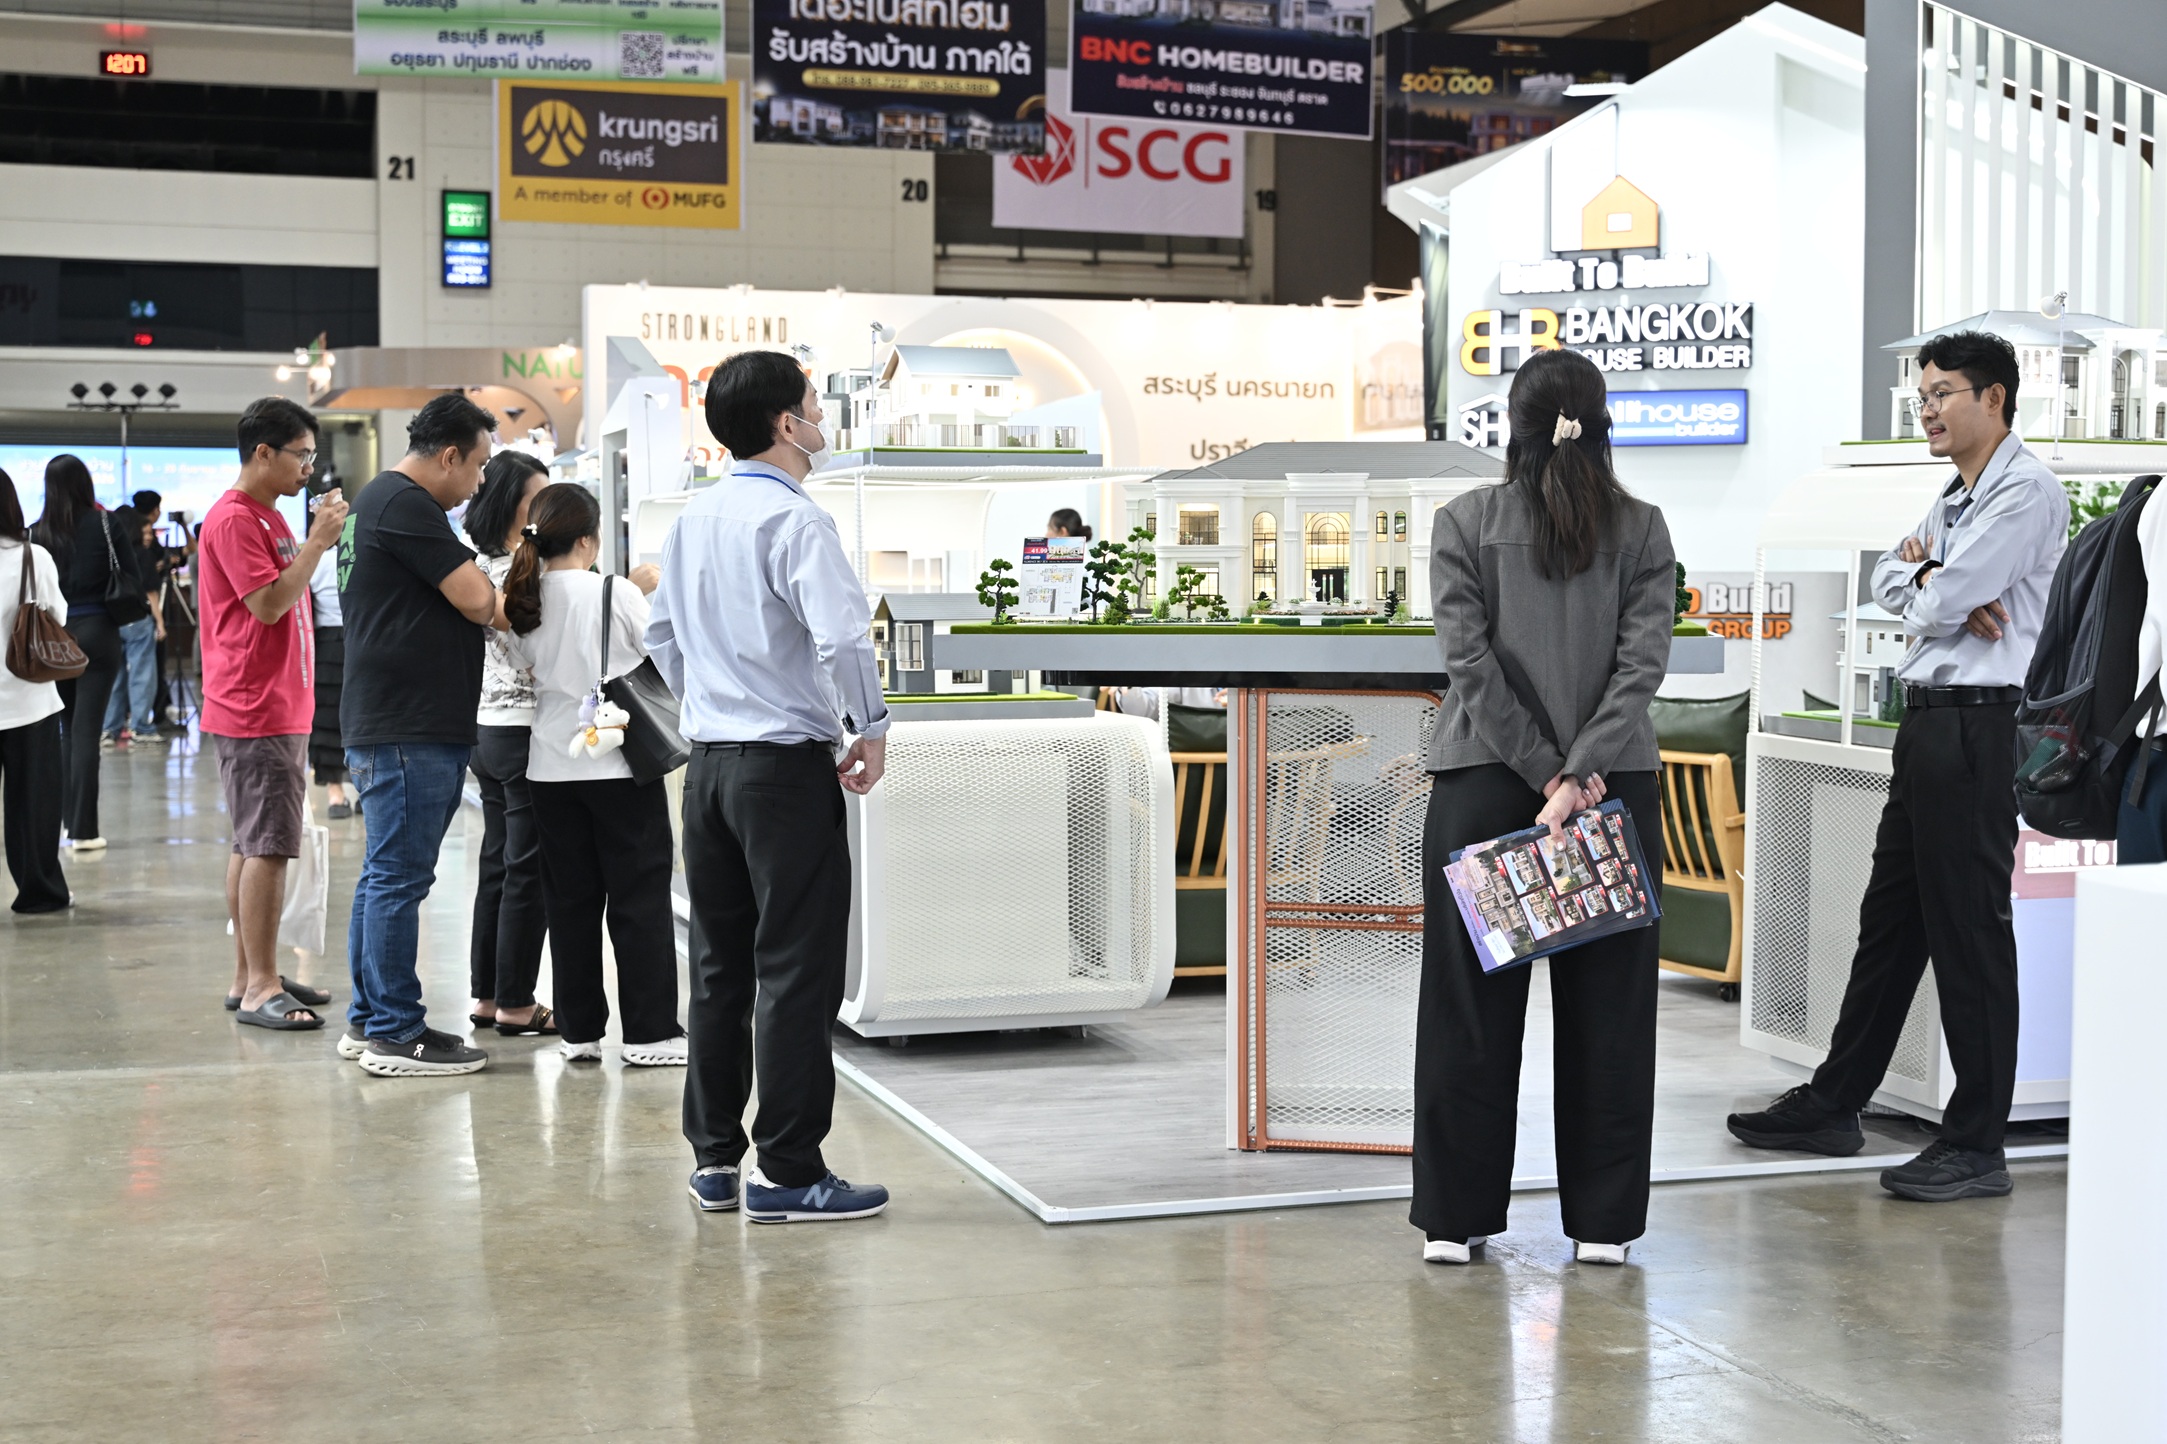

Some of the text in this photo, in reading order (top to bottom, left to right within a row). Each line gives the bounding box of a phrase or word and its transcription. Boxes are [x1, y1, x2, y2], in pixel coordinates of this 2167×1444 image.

[437, 27, 544, 50] สระบุรี ลพบุรี
[769, 27, 1031, 75] รับสร้างบ้าน ภาคใต้
[453, 52, 519, 74] ปทุมธานี
[527, 55, 592, 71] ปากช่อง
[1080, 35, 1364, 84] BNC HOMEBUILDER
[1400, 73, 1493, 96] 500,000
[599, 111, 718, 146] krungsri
[599, 146, 654, 171] กรุงศรี
[1096, 126, 1232, 184] SCG
[388, 156, 415, 181] 21
[514, 186, 727, 209] A member of MUFG
[902, 178, 928, 202] 20
[448, 212, 482, 227] EXIT
[1578, 257, 1618, 291] To
[641, 312, 789, 344] STRONGLAND
[1565, 301, 1752, 343] BANGKOK
[1578, 345, 1751, 371] OUSE BUILDER
[1144, 372, 1217, 403] สระบุรี
[1226, 378, 1334, 399] นครนายก
[1675, 421, 1739, 437] builder
[1191, 438, 1254, 461] ปราจี
[1707, 620, 1791, 639] GROUP
[2081, 839, 2109, 865] To
[801, 1184, 834, 1209] N
